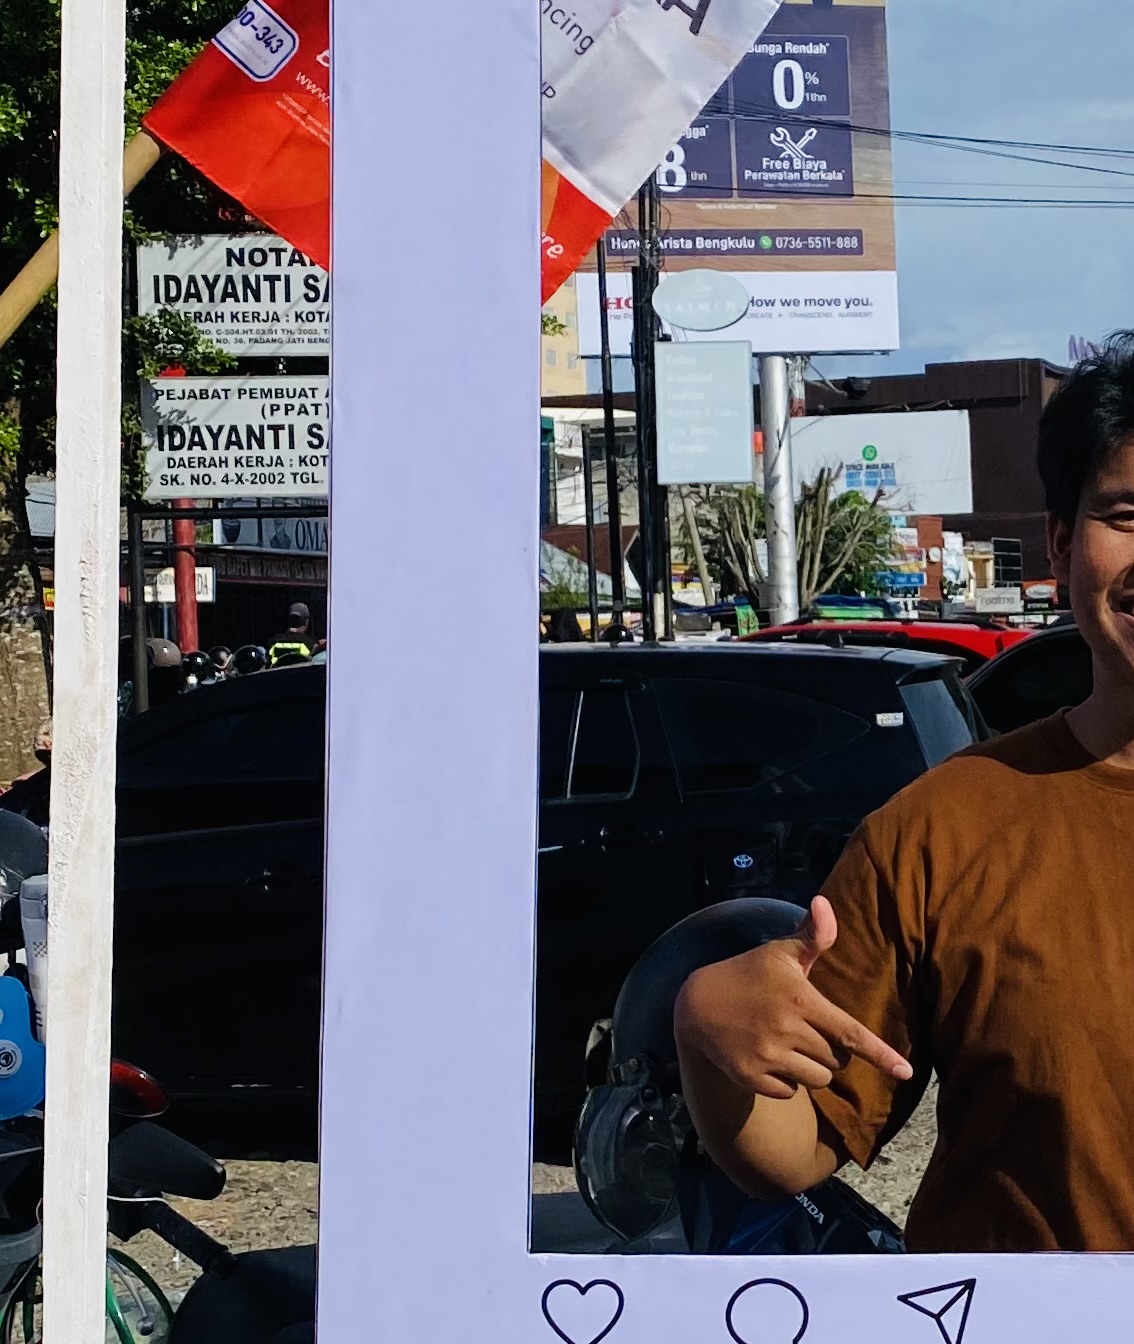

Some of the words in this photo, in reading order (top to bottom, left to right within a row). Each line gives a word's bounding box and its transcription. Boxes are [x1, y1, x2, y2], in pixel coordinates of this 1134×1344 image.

[762, 157, 790, 170] Free
[792, 158, 827, 171] Biaya
[744, 169, 801, 181] Perawatan
[695, 237, 755, 251] Bengkulu
[775, 237, 859, 249] 0736-5511-888
[226, 247, 316, 267] NOTA
[153, 274, 291, 304] IDAYANTI
[781, 299, 801, 308] we
[803, 298, 842, 308] move
[844, 298, 874, 309] you.
[230, 311, 281, 323] KERJA
[156, 388, 232, 401] PEJABAT
[237, 387, 319, 400] PEMBUAT
[157, 423, 295, 452] IDAYANTI
[306, 422, 329, 451] S
[167, 456, 229, 469] DAERAH
[233, 455, 285, 469] KERJA
[159, 474, 185, 486] SK.
[190, 474, 217, 486] NO.
[220, 472, 286, 486] 4-X-2002
[290, 471, 324, 485] TGL.
